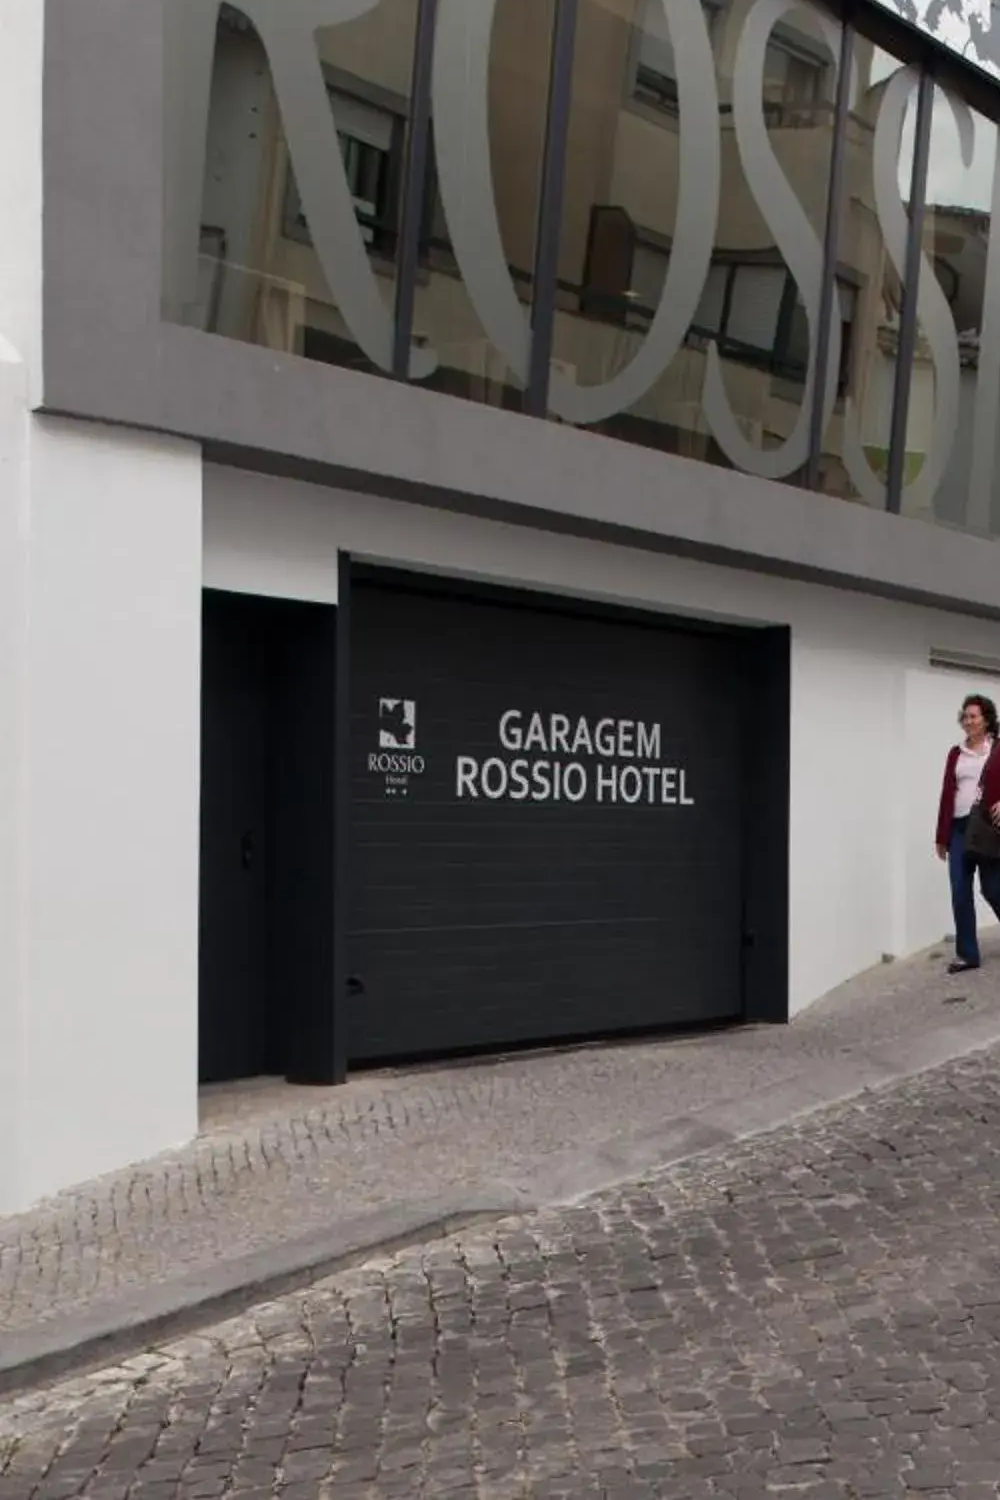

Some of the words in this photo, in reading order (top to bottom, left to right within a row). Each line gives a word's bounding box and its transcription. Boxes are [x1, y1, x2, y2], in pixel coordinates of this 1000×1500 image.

[500, 710, 661, 760] GARAGEM
[367, 752, 425, 774] ROSSIO
[456, 756, 588, 801] ROSSIO
[597, 764, 694, 805] HOTEL
